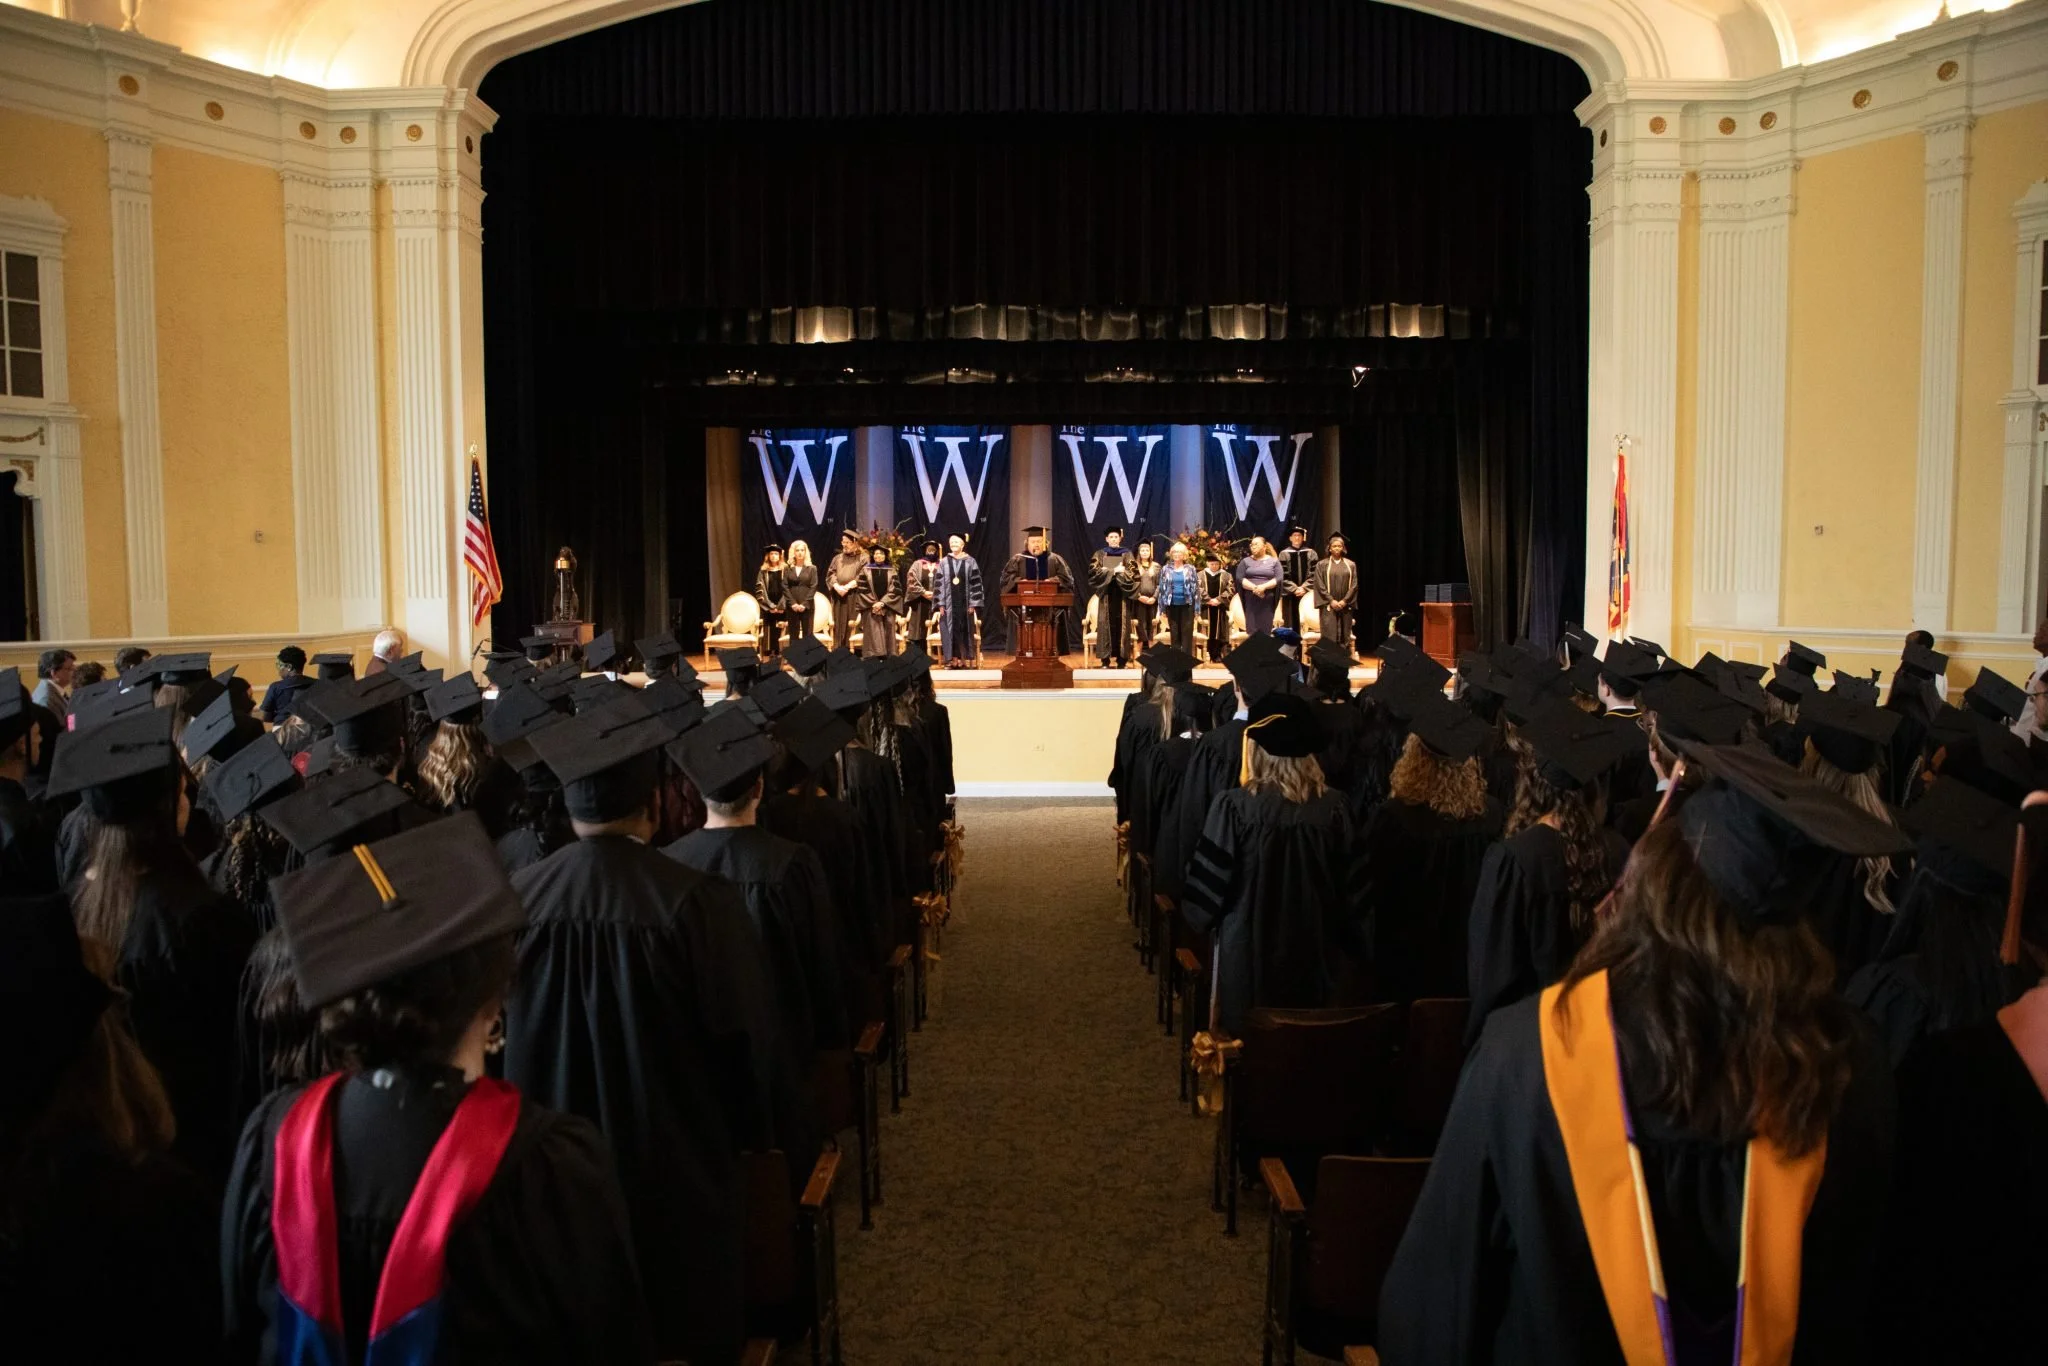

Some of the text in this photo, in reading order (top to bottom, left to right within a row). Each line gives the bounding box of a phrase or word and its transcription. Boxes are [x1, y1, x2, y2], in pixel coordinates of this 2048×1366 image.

[748, 435, 848, 525] W
[901, 434, 1004, 524] W
[1059, 434, 1164, 524] W
[1211, 432, 1313, 522] W
